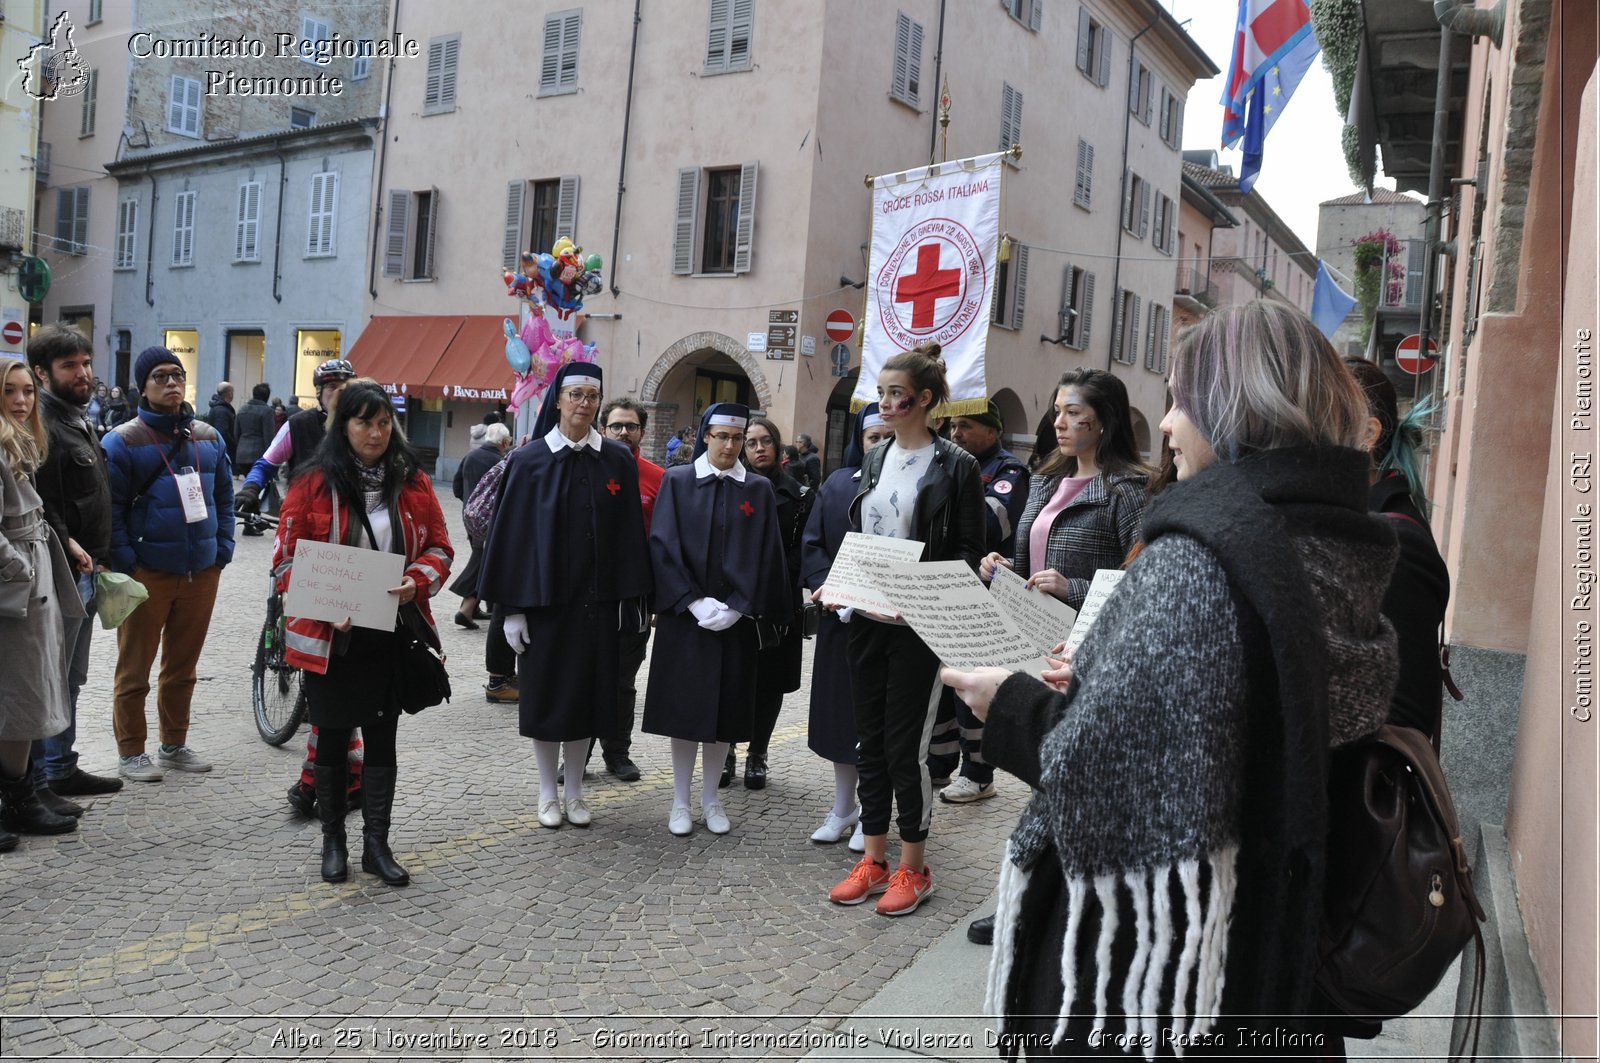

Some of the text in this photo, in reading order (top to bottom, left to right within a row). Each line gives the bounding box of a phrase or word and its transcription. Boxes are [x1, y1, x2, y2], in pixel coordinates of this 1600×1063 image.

[883, 180, 989, 214] CROCE ROSSA ITALIANA
[880, 223, 980, 287] CONVENZIONE DI GINEVRA 22 AGOSTO 1864
[883, 307, 899, 335] CORPO
[935, 299, 978, 343] VOLONTARIE
[453, 385, 479, 398] BANCA
[316, 550, 341, 561] NON
[311, 563, 366, 582] NORMALE
[297, 580, 320, 590] CHE
[314, 596, 362, 612] NORMALE
